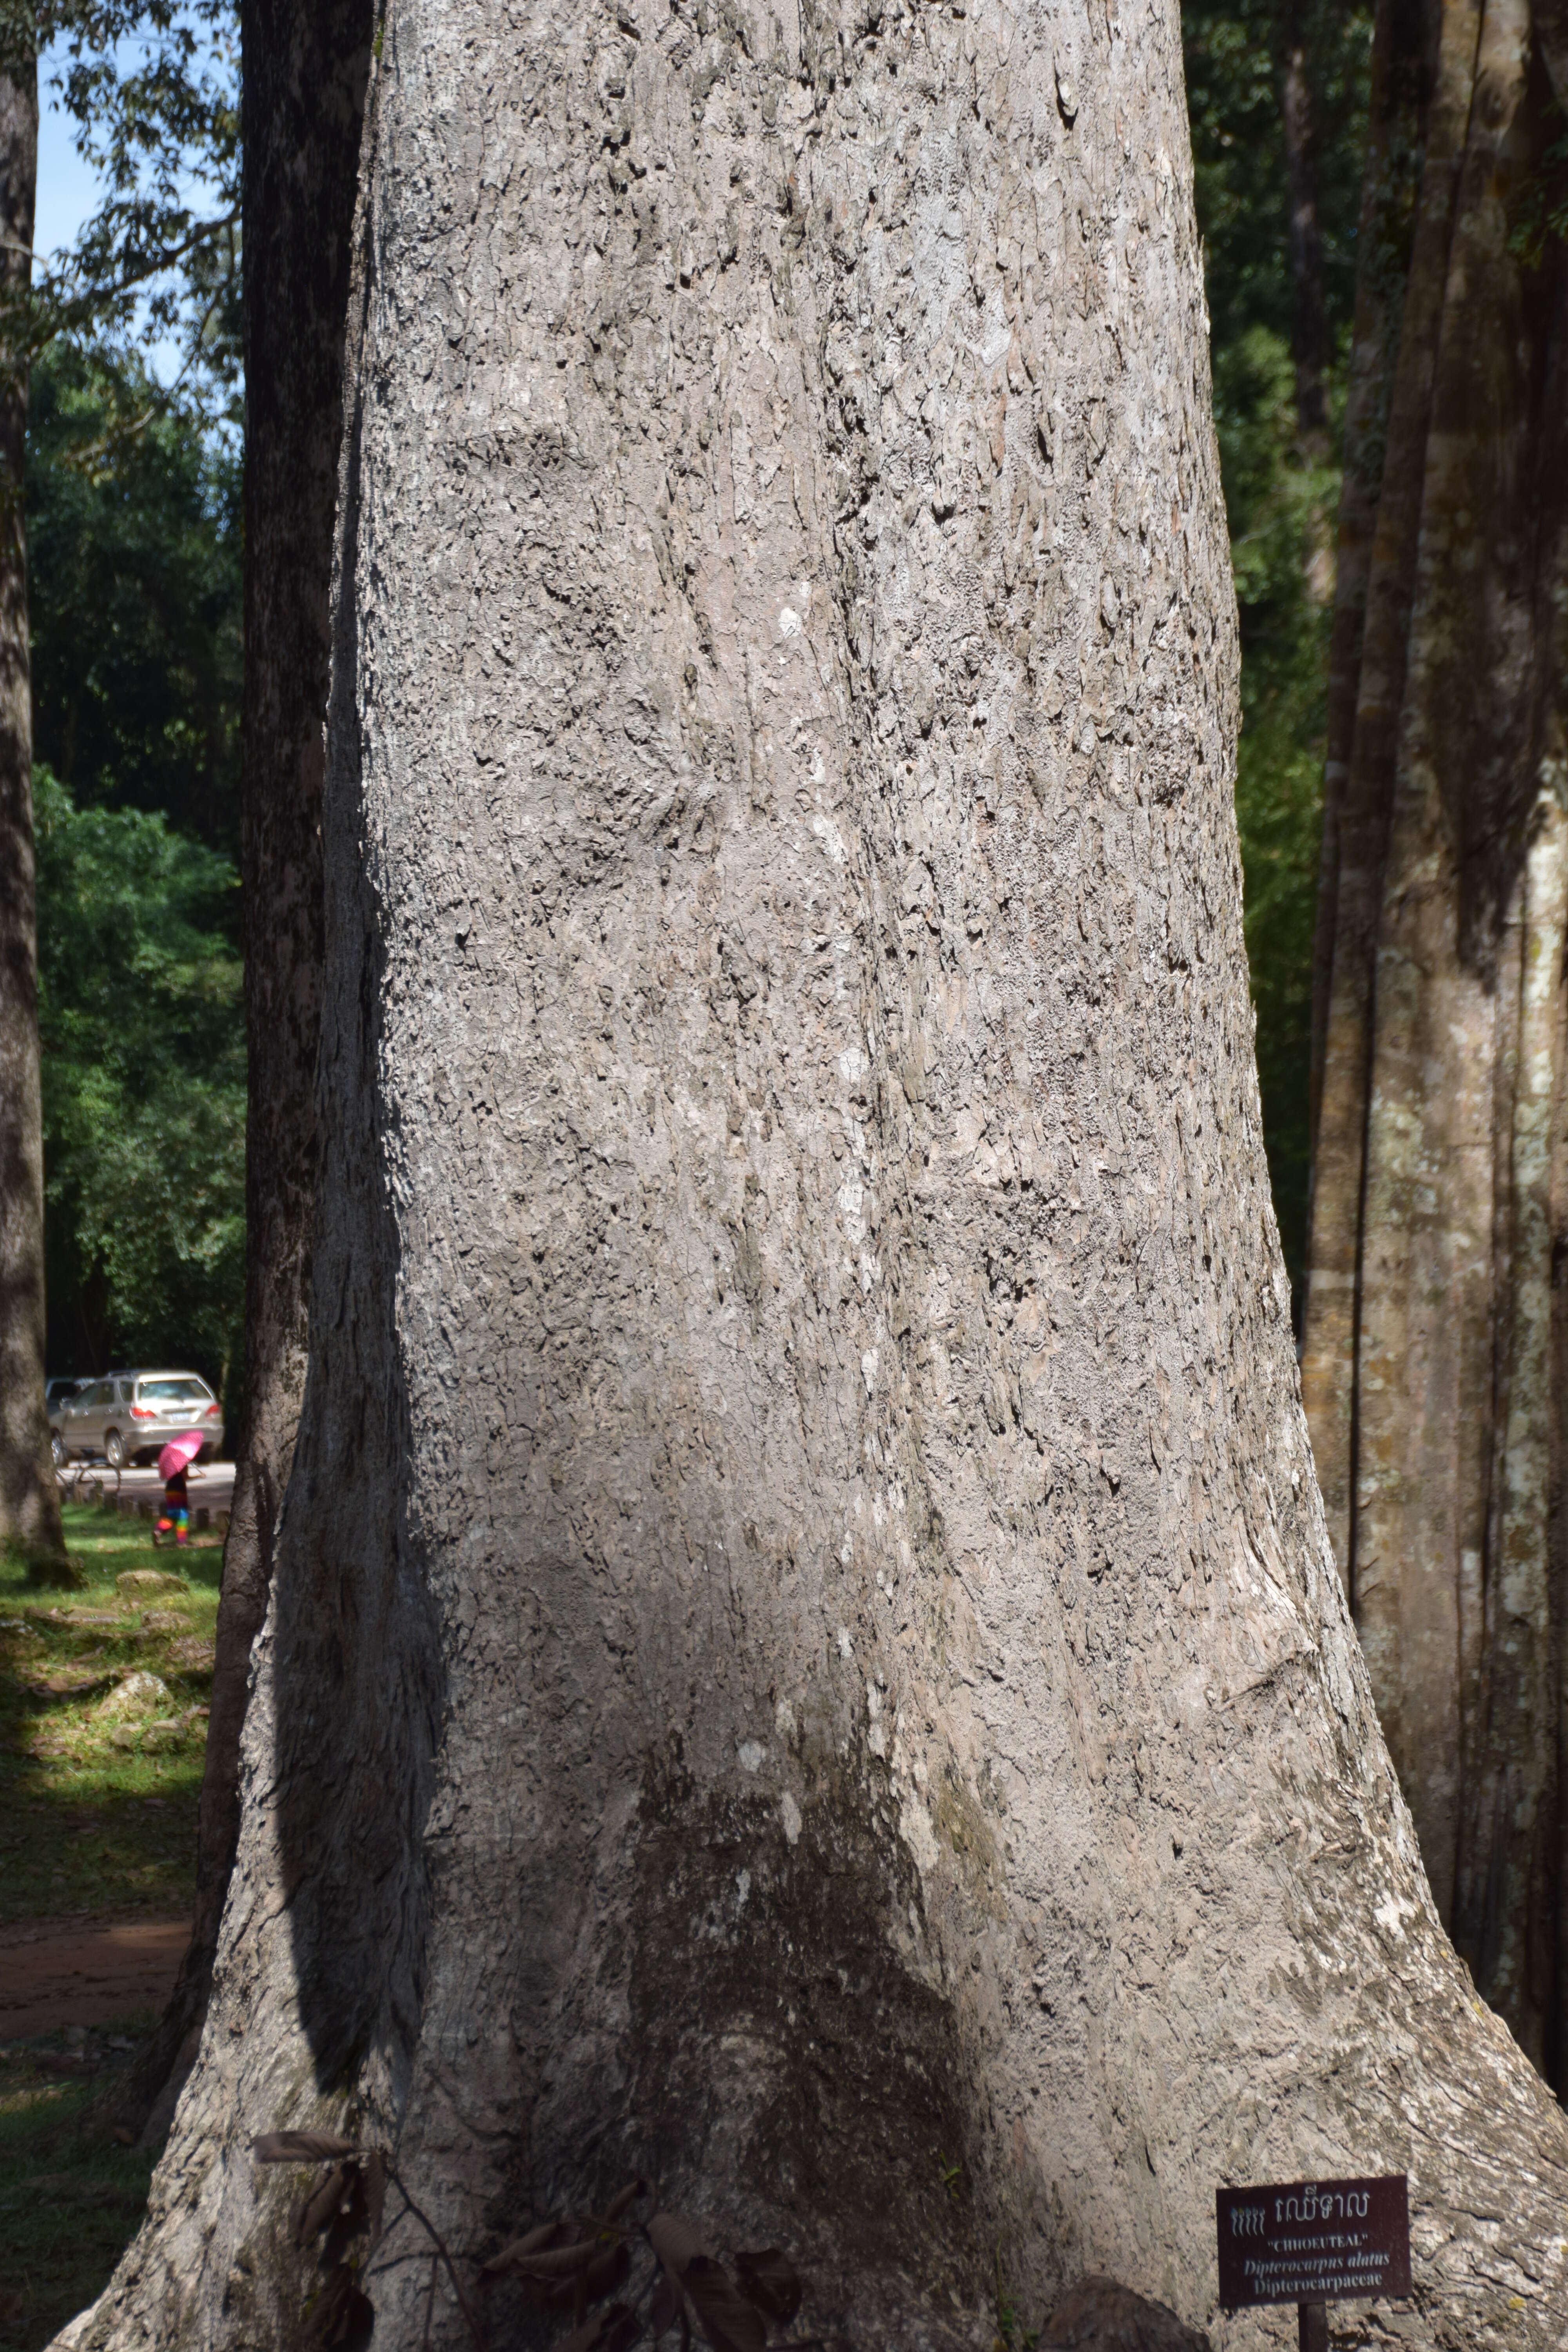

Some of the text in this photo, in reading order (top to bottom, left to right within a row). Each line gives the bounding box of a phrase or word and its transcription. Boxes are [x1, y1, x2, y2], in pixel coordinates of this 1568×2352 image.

[1268, 2234, 1368, 2252] "CHHOEUTEAL"
[1244, 2252, 1390, 2278] Dipterocarpus alatus
[1255, 2274, 1382, 2296] Dipterocarpaceae
